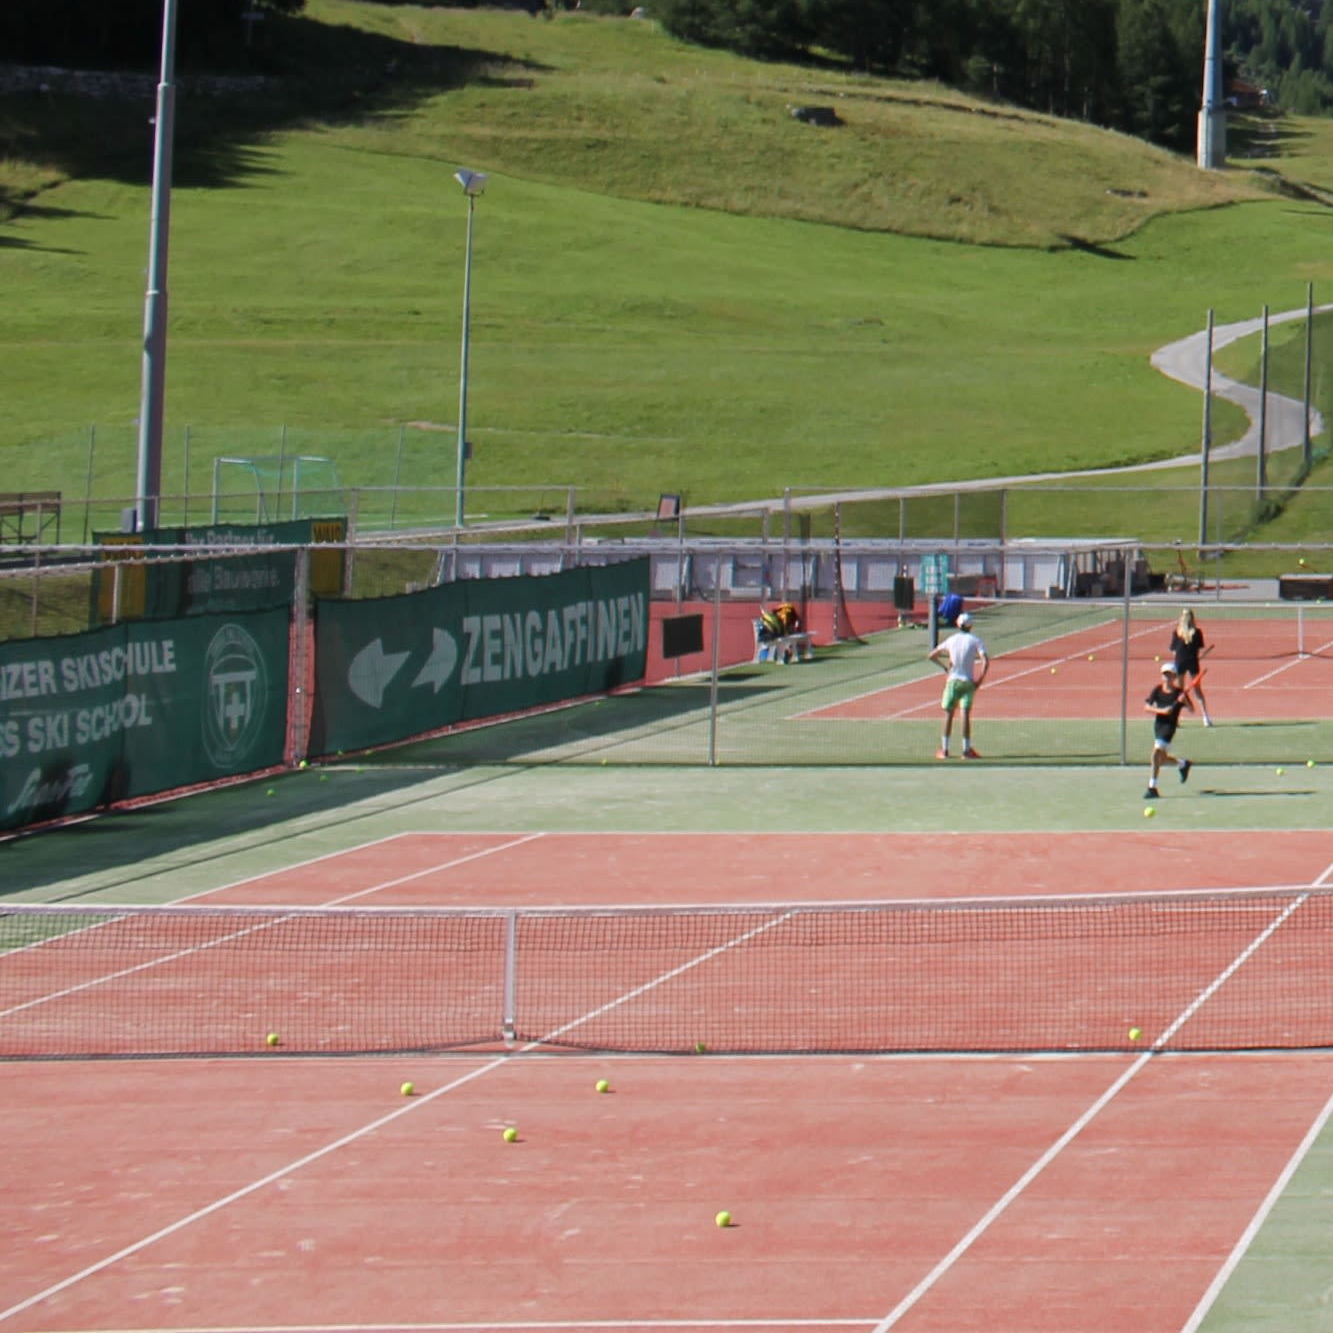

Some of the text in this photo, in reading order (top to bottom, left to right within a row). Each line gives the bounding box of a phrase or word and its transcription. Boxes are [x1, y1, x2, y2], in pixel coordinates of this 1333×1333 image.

[460, 592, 644, 686] ZENGAFFINEN
[61, 640, 177, 692] SKISCHULE
[27, 714, 70, 754] SKI
